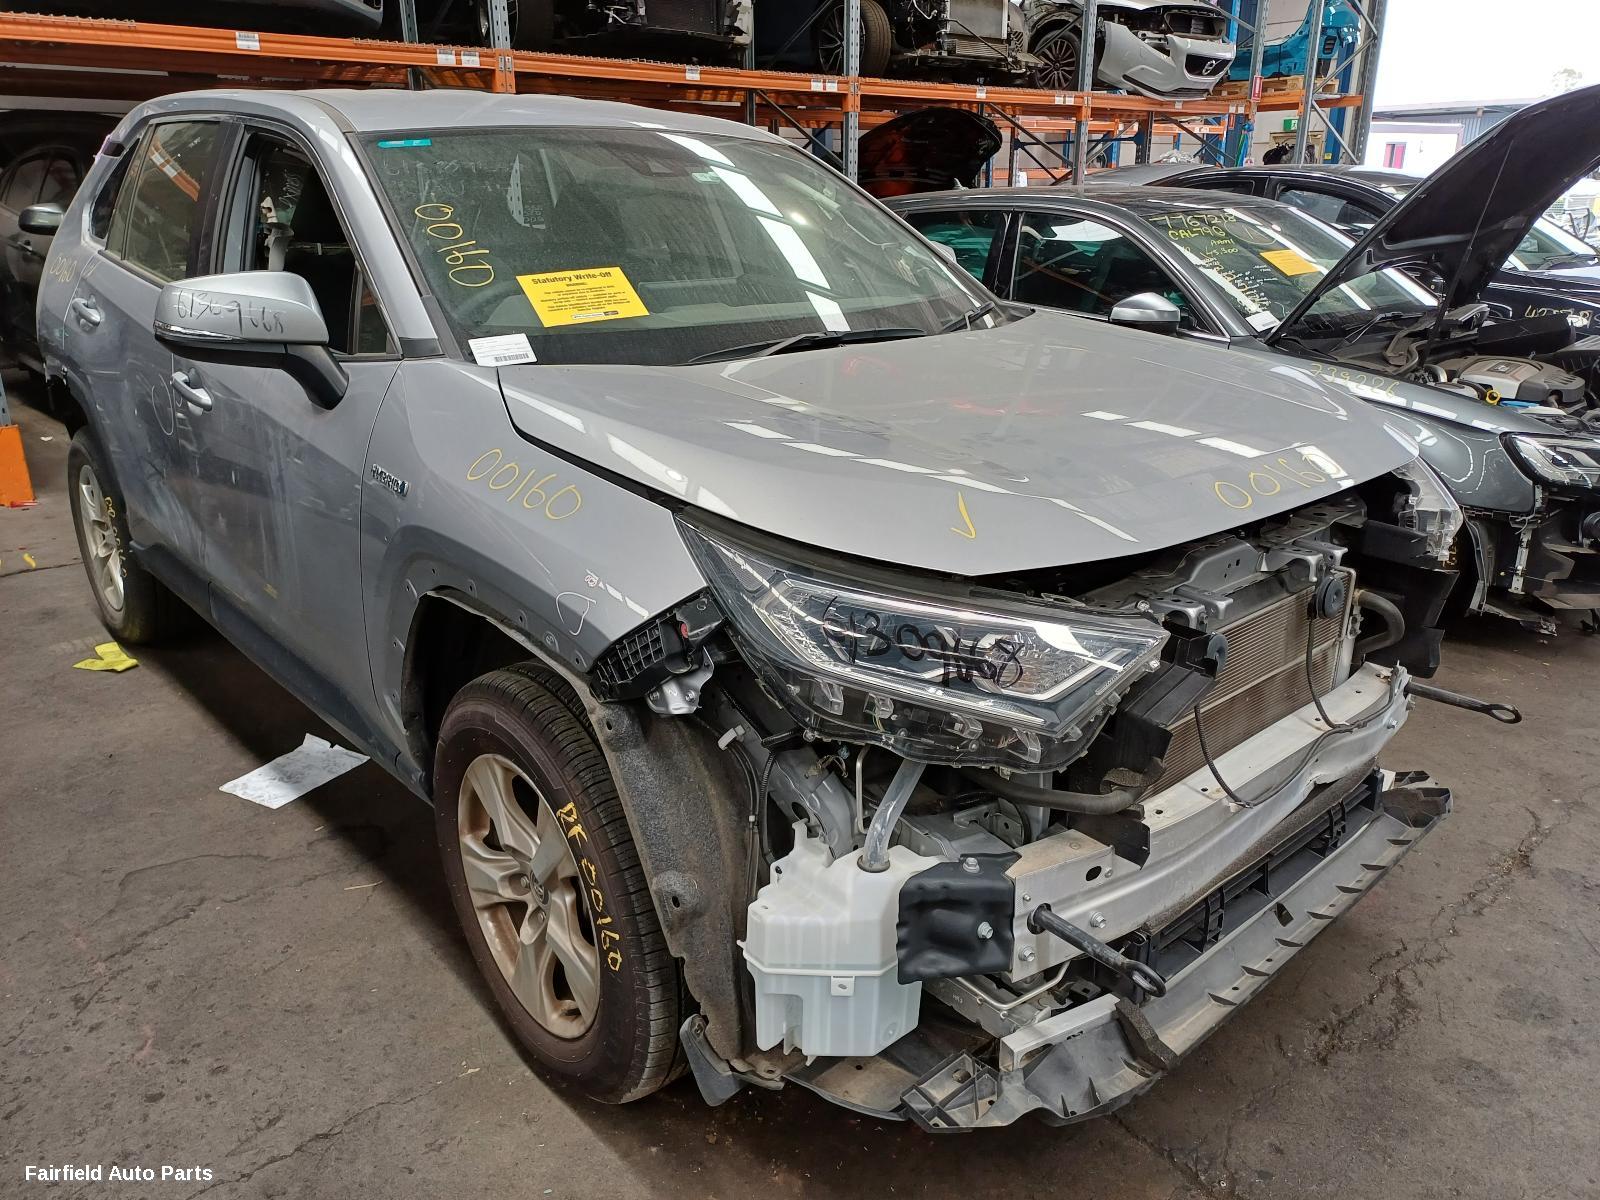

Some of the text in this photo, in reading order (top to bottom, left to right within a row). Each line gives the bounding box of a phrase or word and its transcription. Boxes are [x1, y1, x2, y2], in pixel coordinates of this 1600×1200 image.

[531, 275, 573, 285] Statutory
[574, 271, 613, 281] Write-Off
[466, 448, 583, 520] 00160
